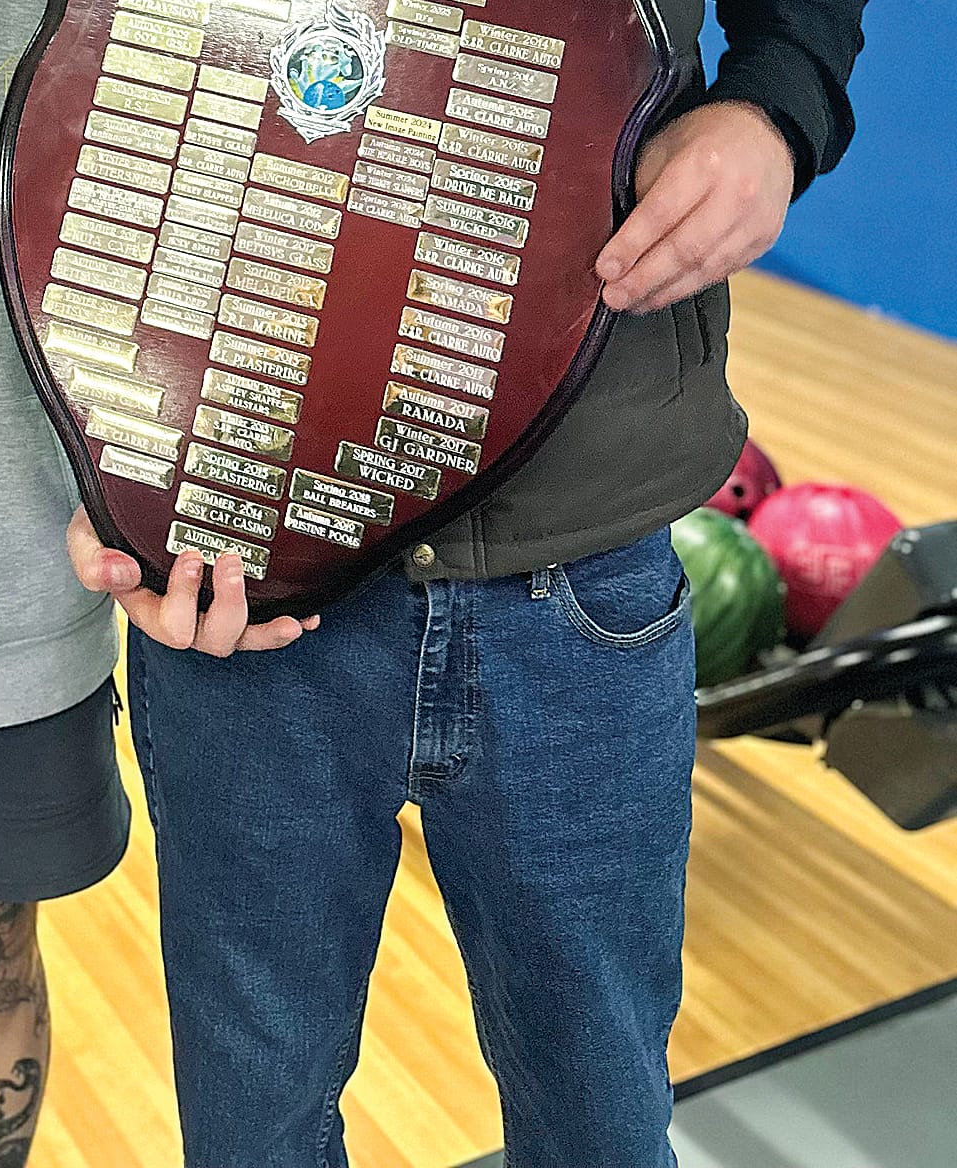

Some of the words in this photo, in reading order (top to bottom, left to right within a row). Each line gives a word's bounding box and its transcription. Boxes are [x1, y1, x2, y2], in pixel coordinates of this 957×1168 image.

[480, 25, 519, 42] Winter
[523, 35, 549, 50] 2014
[489, 42, 529, 59] CLARKE
[532, 51, 560, 67] AUTO
[463, 95, 505, 114] Autumn
[368, 118, 382, 128] New
[385, 123, 406, 134] Image
[408, 128, 437, 141] Painting
[375, 111, 408, 124] Summer
[474, 111, 514, 128] CLARKE
[516, 121, 544, 135] AUTO
[459, 129, 497, 146] Winter
[502, 139, 528, 153] 2015
[468, 145, 509, 165] CLARKE
[511, 156, 539, 172] AUTO
[450, 164, 490, 184] Spring
[444, 177, 476, 196] DRIVE
[479, 187, 496, 201] ME
[499, 190, 532, 210] BATTY
[436, 200, 484, 221] SUMMER
[488, 213, 516, 229] 2016
[450, 217, 498, 237] WICKED
[289, 253, 327, 269] GLASS
[434, 237, 473, 255] Winter
[478, 250, 505, 265] 2016
[244, 263, 281, 282] Spring
[444, 256, 484, 275] CLARKE
[425, 277, 463, 296] Spring
[232, 299, 278, 320] Summer
[431, 292, 483, 314] RAMADA
[253, 319, 306, 343] MARINE
[415, 312, 460, 332] Autumn
[464, 326, 492, 342] 2016
[223, 336, 270, 357] Summer
[428, 331, 469, 351] CLARKE
[472, 340, 501, 361] AUTO
[234, 354, 307, 383] PLASTERING
[406, 349, 454, 371] Summer
[459, 363, 483, 380] 2017
[420, 369, 461, 390] CLARKE
[464, 381, 493, 398] AUTO
[399, 388, 445, 409] Autumn
[450, 403, 477, 419] 2017
[401, 403, 466, 432] RAMADA
[150, 441, 178, 458] AUTO
[395, 424, 435, 444] Winter
[440, 438, 467, 454] 2017
[352, 448, 396, 471] SPRING
[400, 463, 425, 479] 2017
[379, 435, 398, 452] GJ
[403, 442, 474, 473] GARDNER
[209, 466, 277, 495] PLASTERING
[359, 464, 415, 491] WICKED
[192, 490, 235, 511] SUMMER
[303, 490, 326, 505] BALL
[329, 496, 377, 519] BREAKERS
[210, 509, 231, 524] CAT
[233, 518, 271, 537] CASINO
[287, 518, 326, 537] PRISTINE
[328, 531, 361, 547] POOLS
[184, 529, 227, 550] AUTUMN
